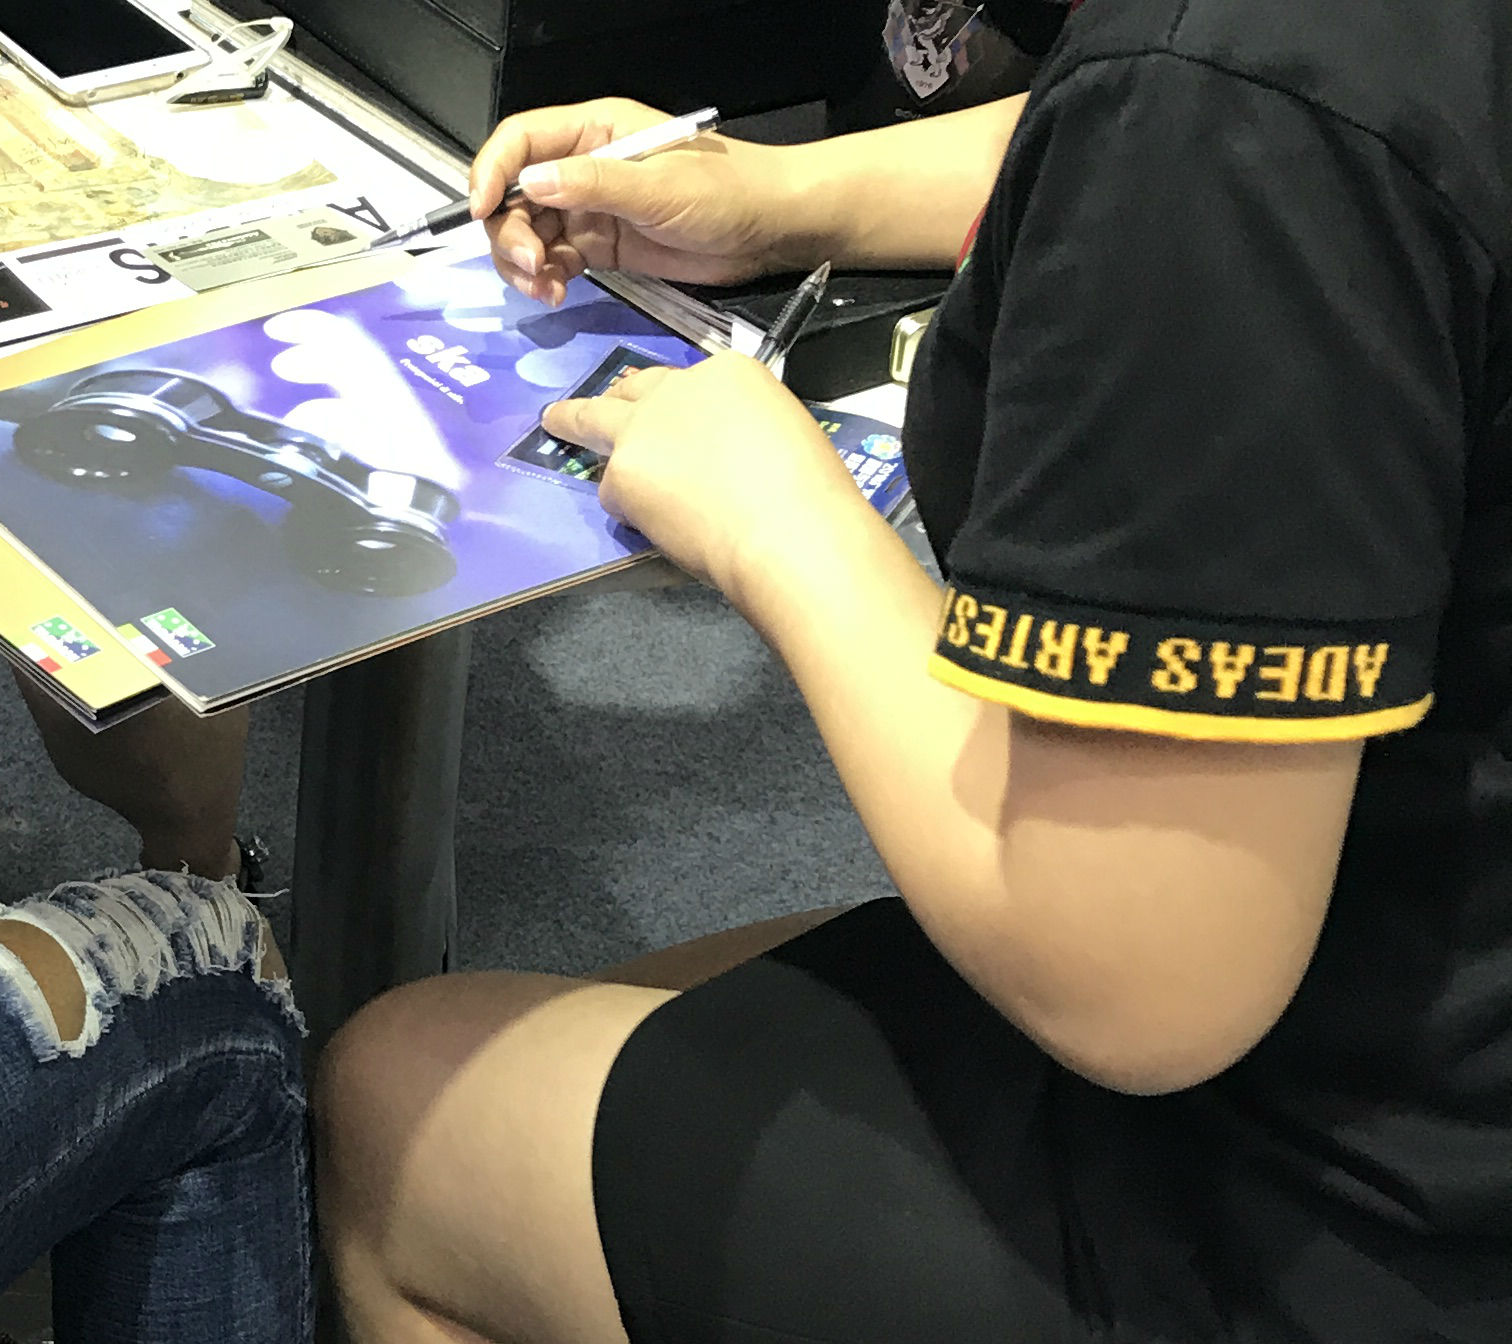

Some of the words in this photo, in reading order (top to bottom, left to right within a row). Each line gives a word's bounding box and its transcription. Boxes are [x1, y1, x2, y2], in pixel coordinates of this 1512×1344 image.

[405, 334, 491, 388] ska
[940, 588, 1131, 686] ARTES
[1149, 637, 1392, 703] ADEAS
